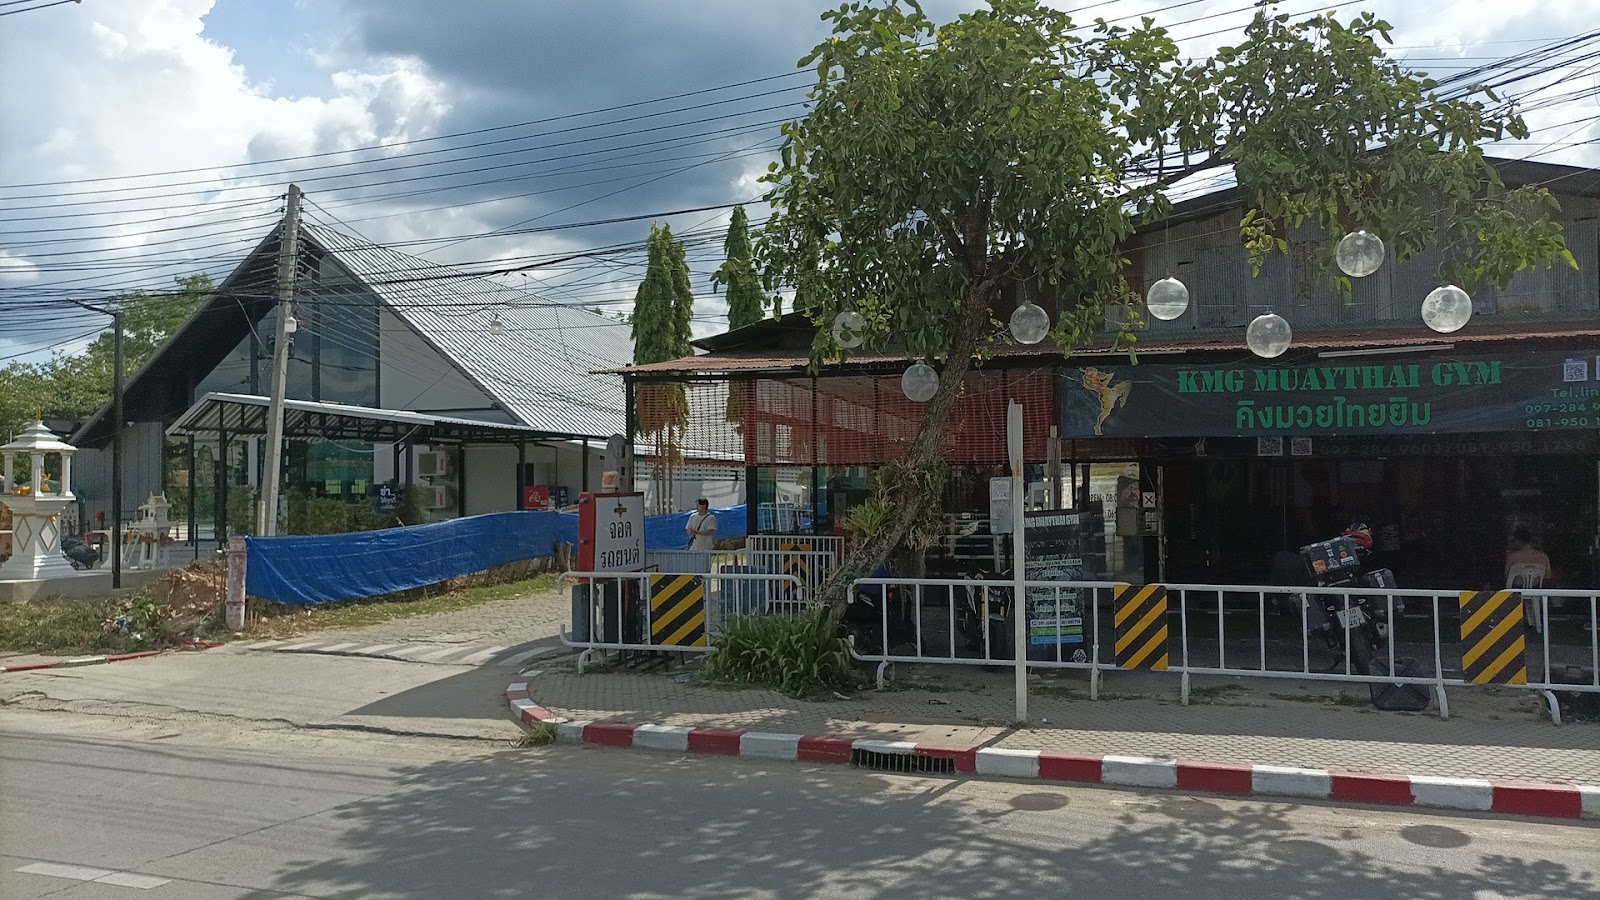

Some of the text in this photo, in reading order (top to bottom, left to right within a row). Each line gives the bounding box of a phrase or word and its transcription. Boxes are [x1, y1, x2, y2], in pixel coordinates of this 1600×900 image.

[1177, 360, 1502, 393] KMG MUAYTHAI GYM
[1236, 396, 1432, 429] คิงมวยไทยยิม
[1525, 403, 1587, 414] 097-284
[1526, 417, 1588, 428] 081-950
[609, 520, 632, 539] จอด
[600, 538, 640, 568] รถยนต์
